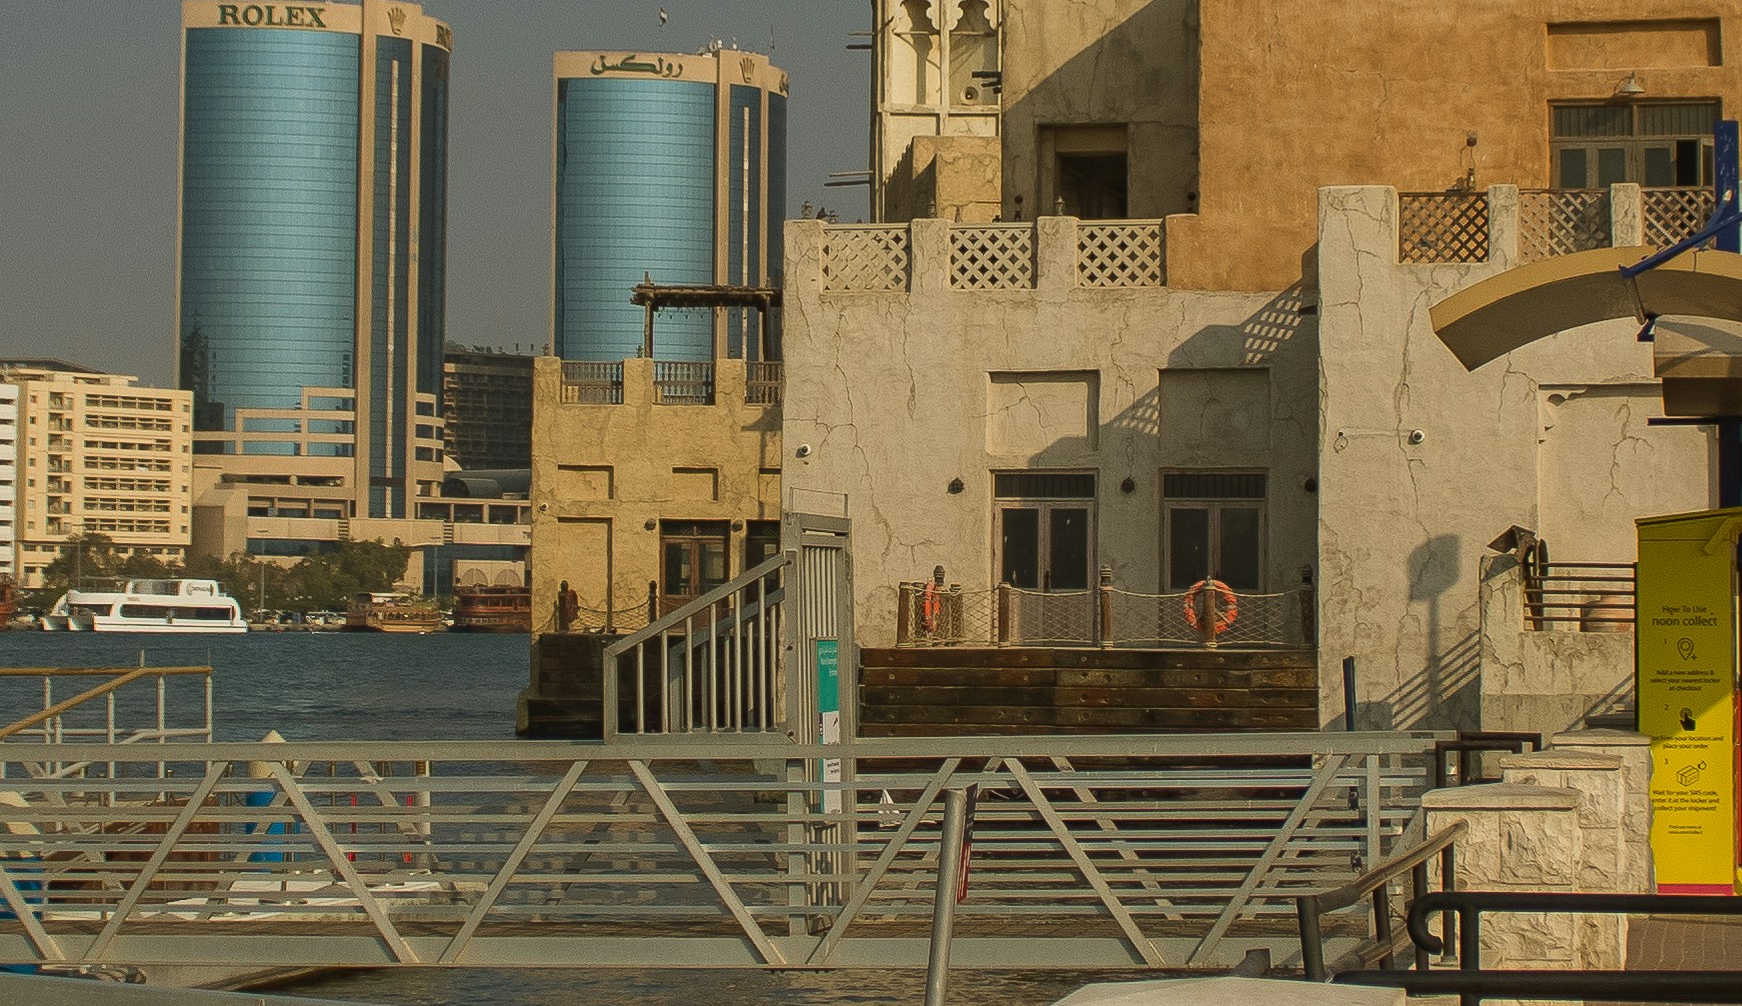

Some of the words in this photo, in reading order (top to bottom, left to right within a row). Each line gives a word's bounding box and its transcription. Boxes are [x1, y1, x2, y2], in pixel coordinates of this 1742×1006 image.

[218, 4, 327, 28] ROLEX
[590, 54, 684, 78] رولكس
[1681, 605, 1692, 613] To
[1693, 605, 1707, 613] Use
[1652, 618, 1680, 626] noon
[1682, 615, 1717, 626] collect
